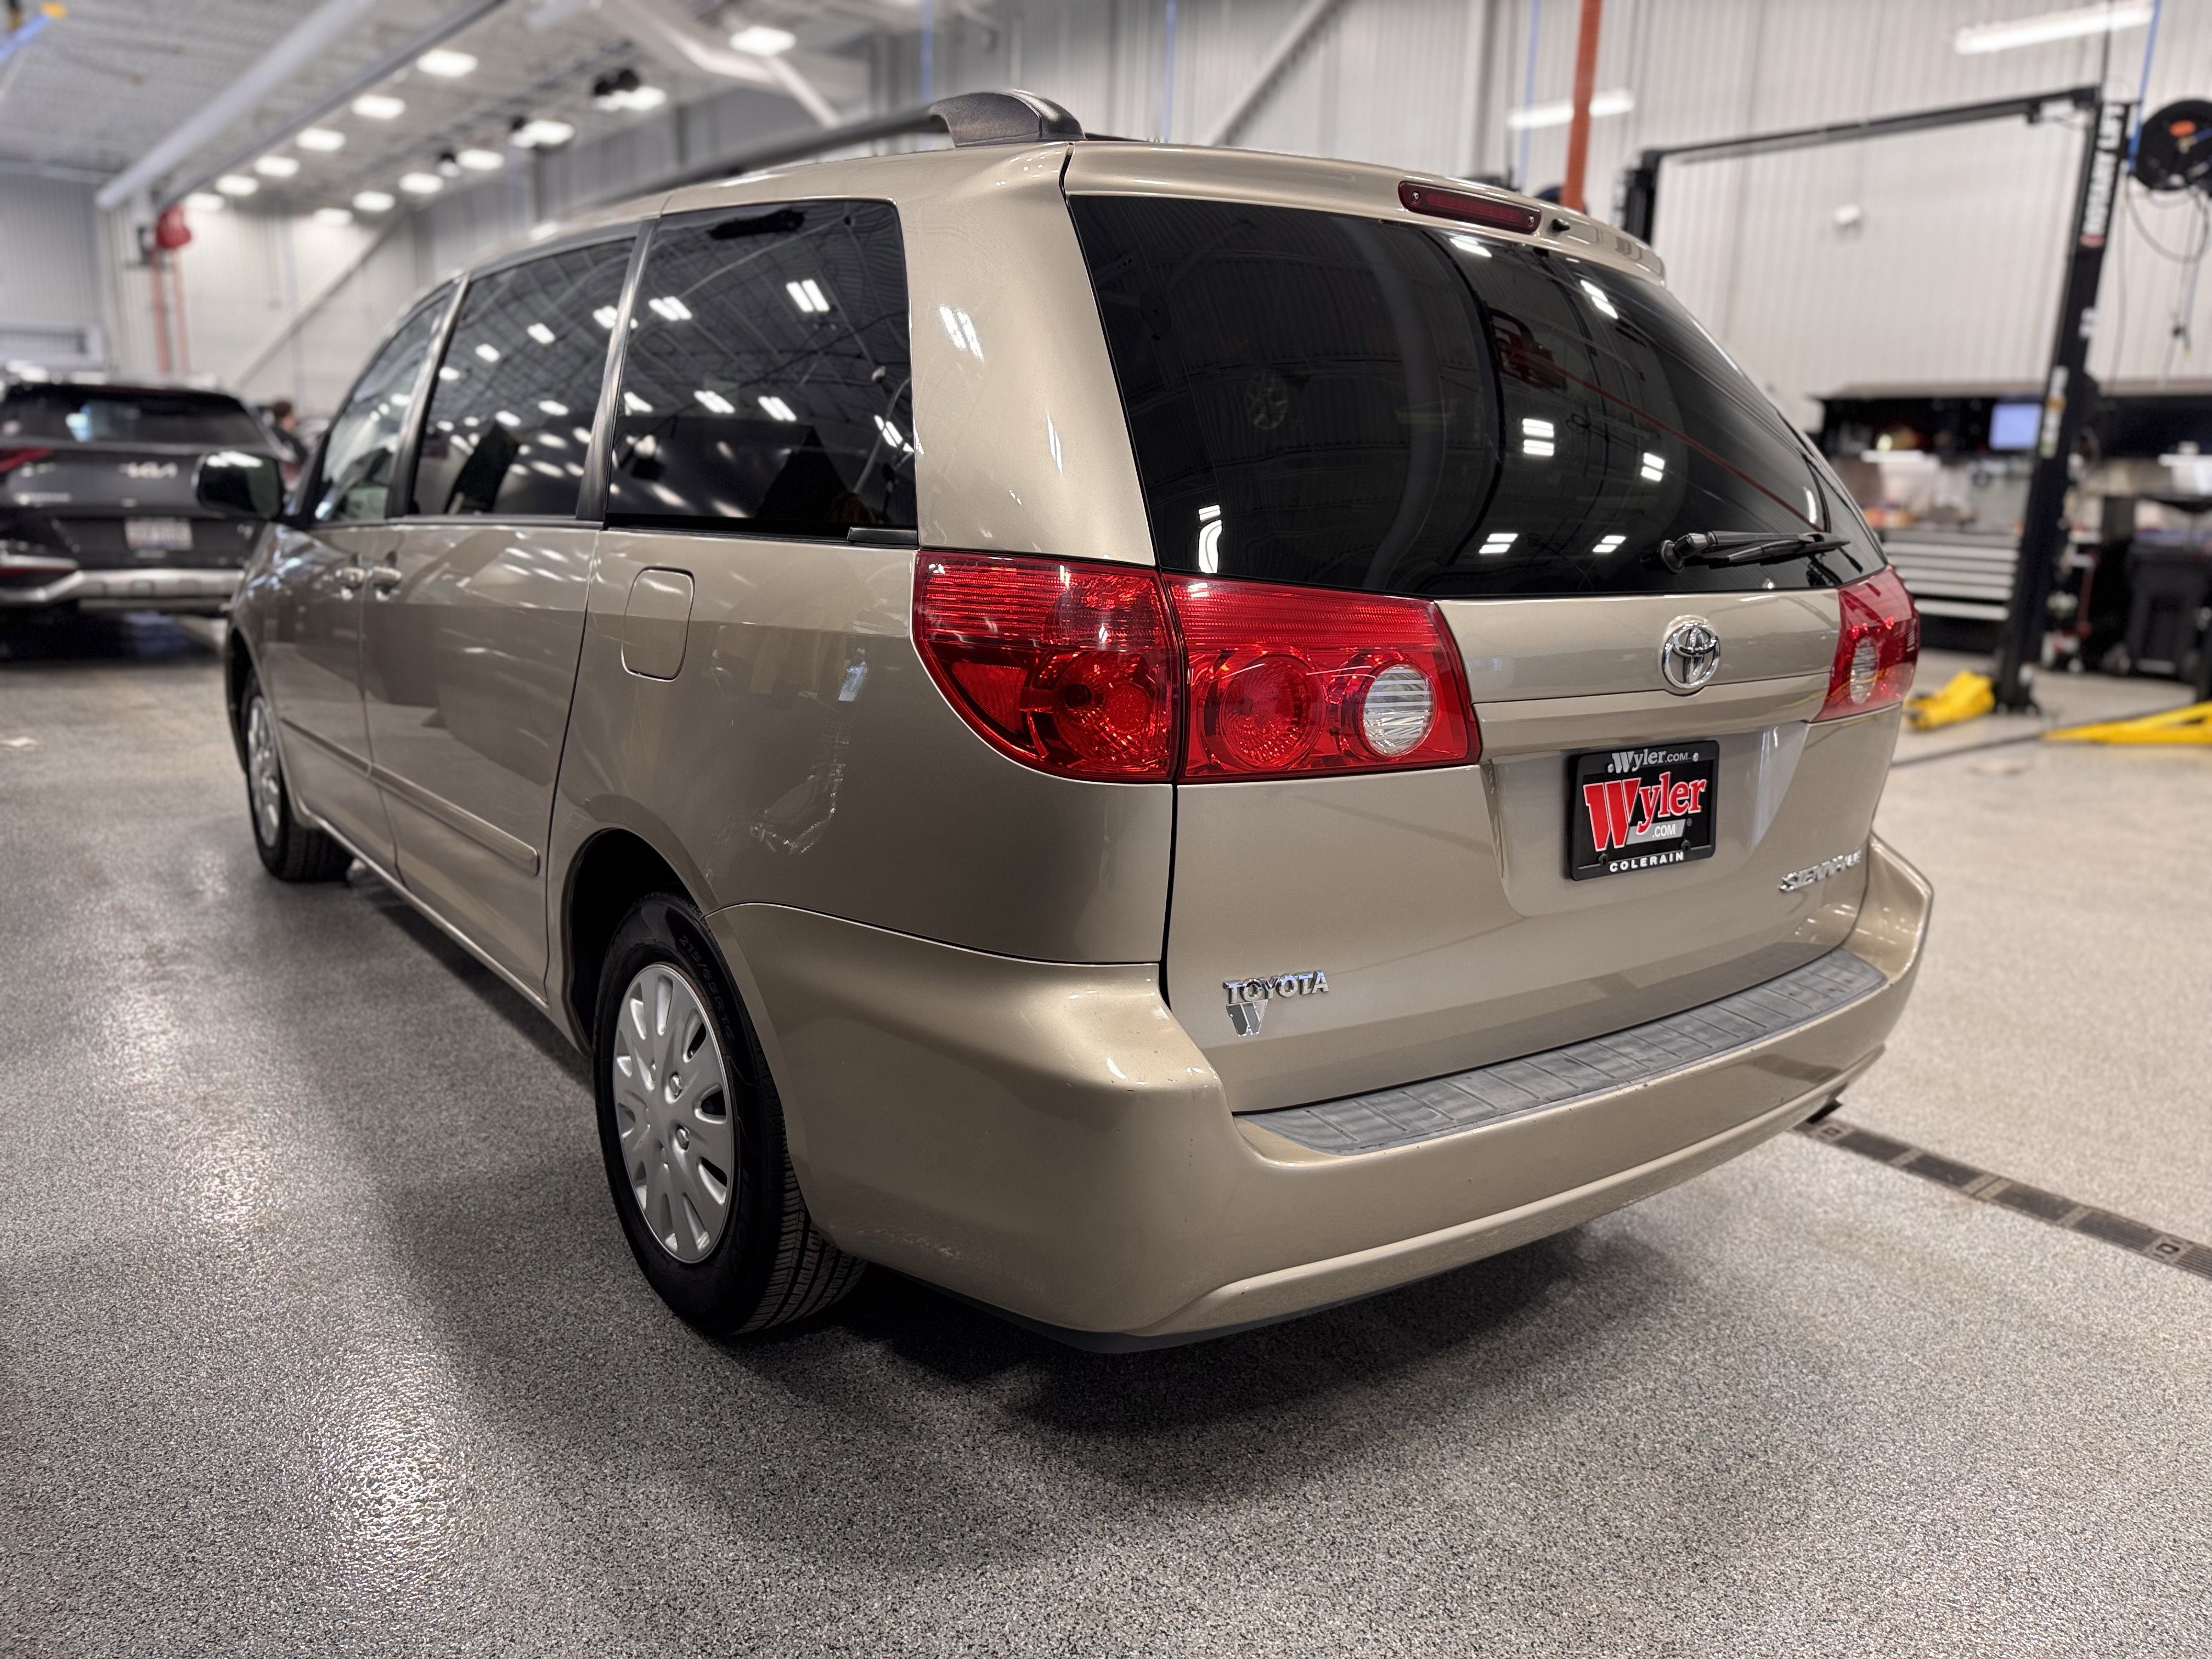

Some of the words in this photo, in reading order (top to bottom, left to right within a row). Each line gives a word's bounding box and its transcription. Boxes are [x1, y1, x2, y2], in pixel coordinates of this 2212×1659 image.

[1583, 771, 1708, 852] Wyler
[1609, 851, 1685, 873] COLERAIN
[1223, 969, 1330, 1004] TOYOTA
